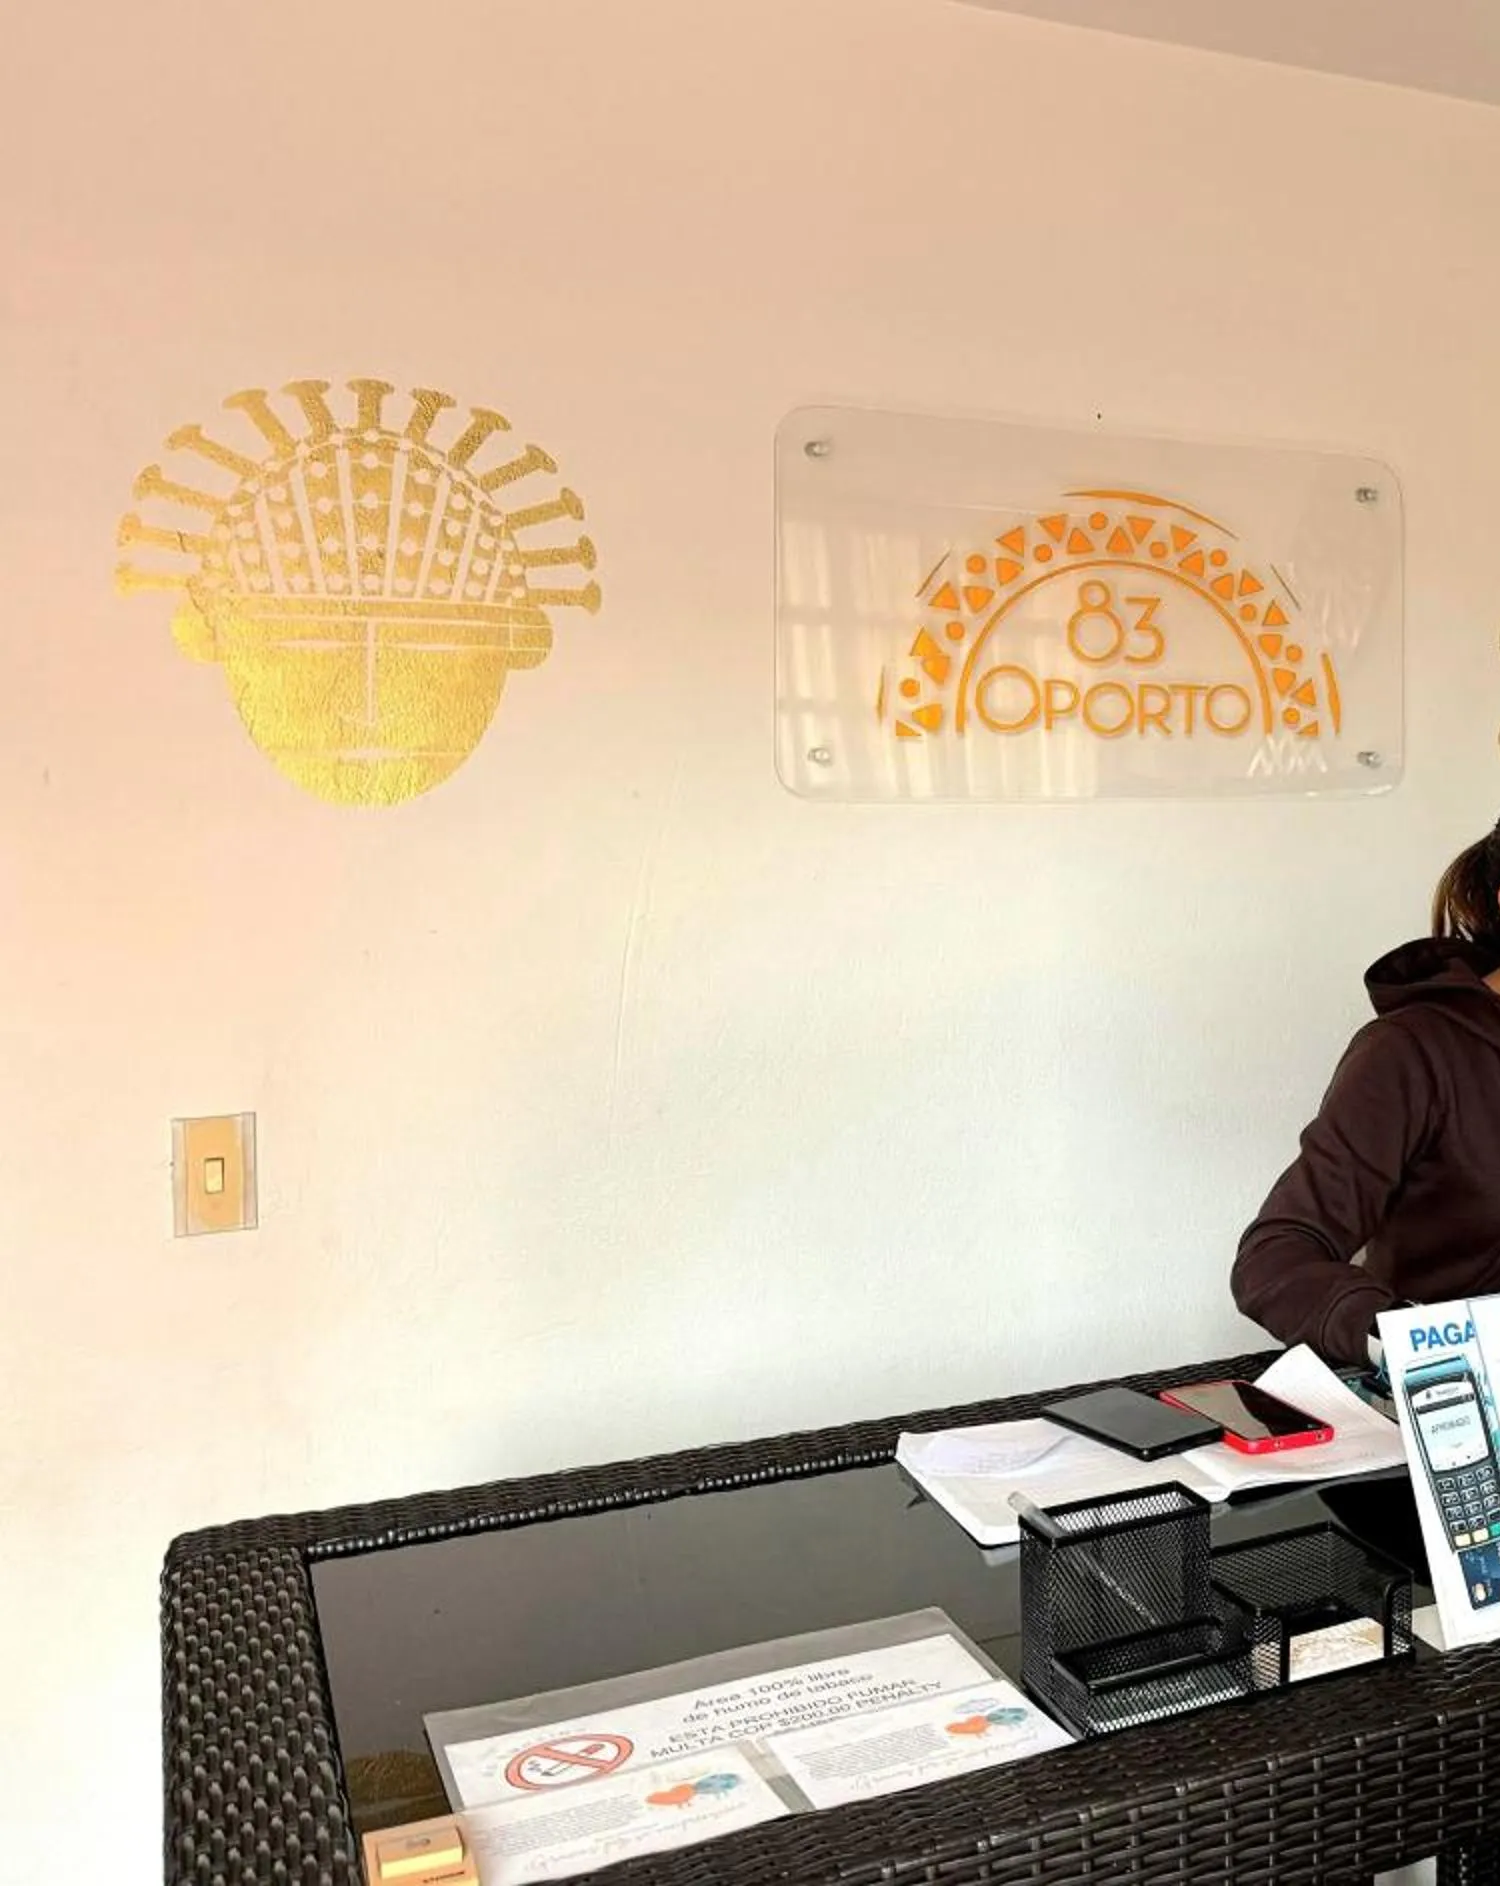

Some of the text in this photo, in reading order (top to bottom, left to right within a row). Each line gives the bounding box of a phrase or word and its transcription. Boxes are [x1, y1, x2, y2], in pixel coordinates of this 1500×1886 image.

[1066, 579, 1166, 665] 83
[974, 664, 1253, 739] OPORTO
[1409, 1319, 1476, 1352] PAGA
[668, 1679, 917, 1743] ESTA PROHIBIDO FUMAR
[682, 1673, 874, 1723] de humo de tabaco
[750, 1677, 804, 1696] 100%
[807, 1668, 850, 1682] libre
[650, 1735, 726, 1758] MULTA
[728, 1721, 773, 1739] COP
[855, 1681, 942, 1709] PENALTY
